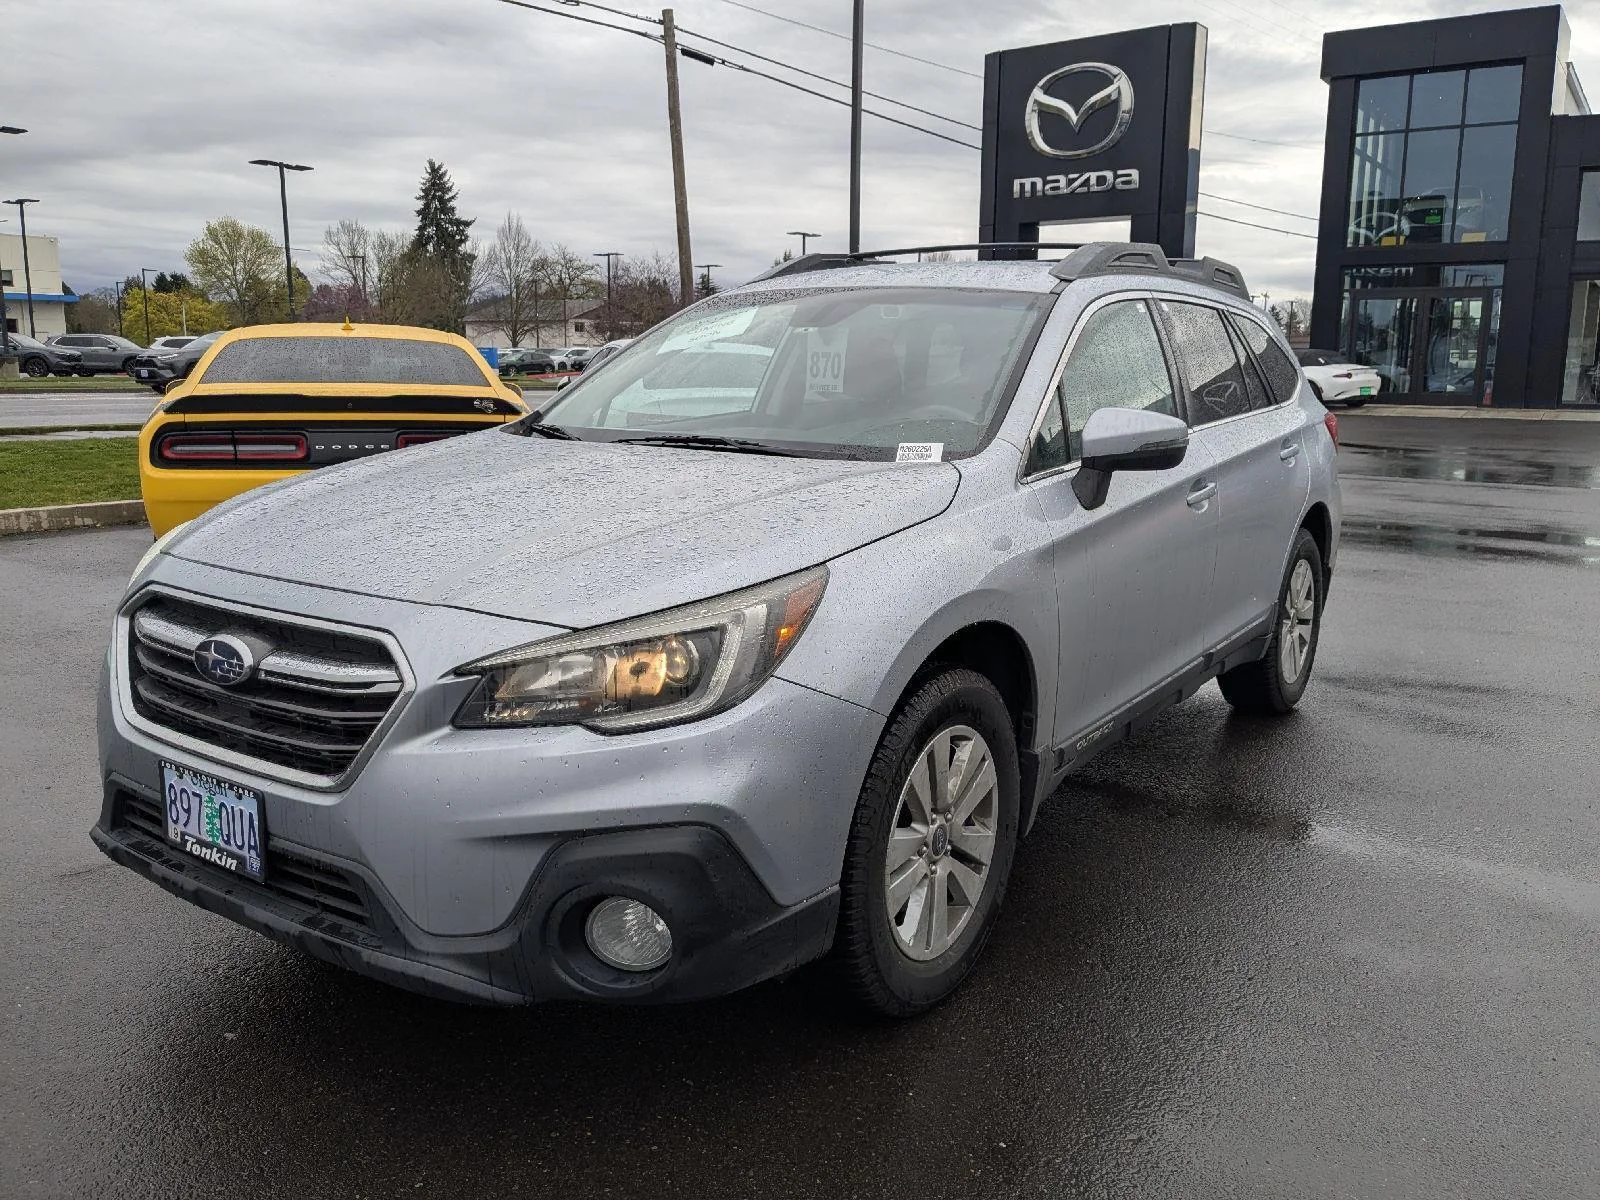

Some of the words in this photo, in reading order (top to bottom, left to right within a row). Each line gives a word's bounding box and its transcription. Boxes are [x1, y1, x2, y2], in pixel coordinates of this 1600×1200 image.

[809, 351, 841, 380] 870
[167, 782, 203, 835] 897
[218, 801, 260, 858] QUA
[184, 835, 238, 871] Tonkin
